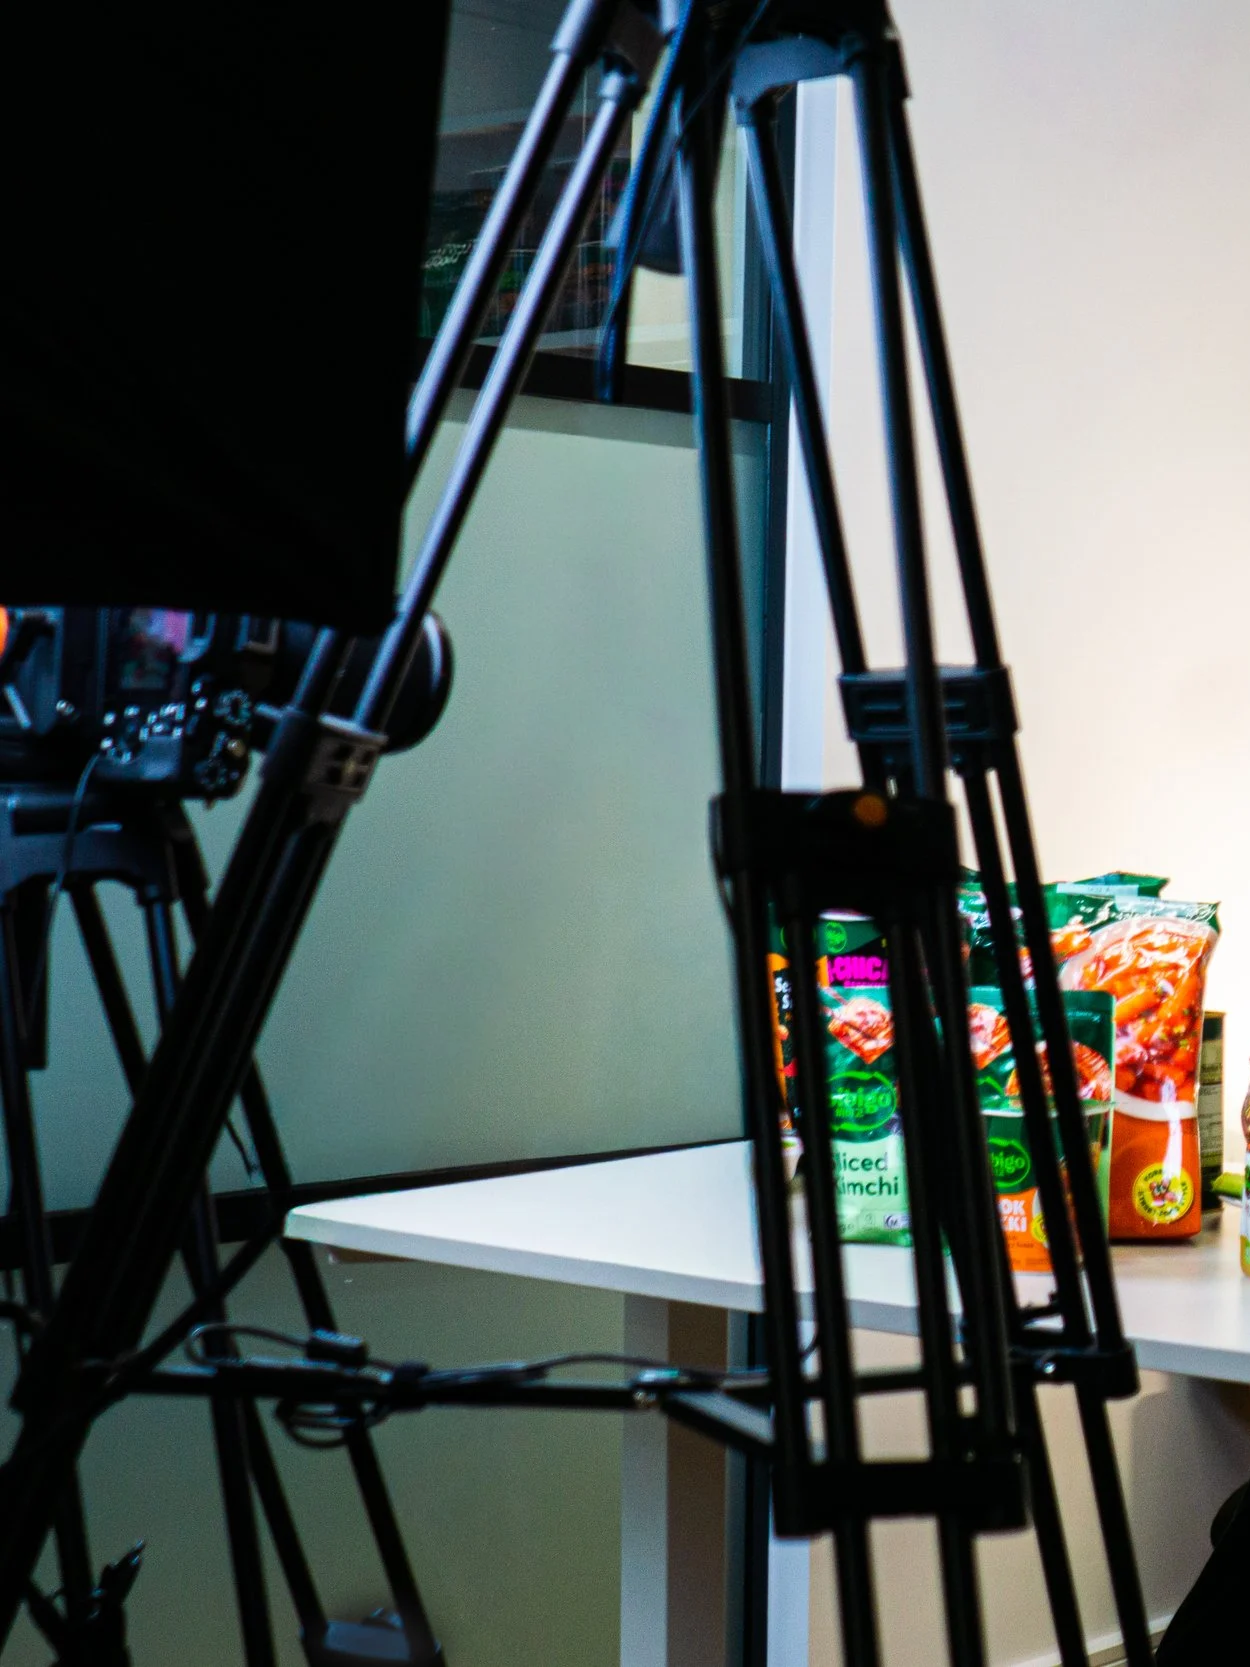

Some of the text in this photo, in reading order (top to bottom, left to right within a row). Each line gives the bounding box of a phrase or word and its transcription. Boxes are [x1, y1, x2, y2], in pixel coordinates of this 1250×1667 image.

[833, 1152, 888, 1171] liced
[991, 1152, 1026, 1174] bigo
[838, 1177, 899, 1196] imchi
